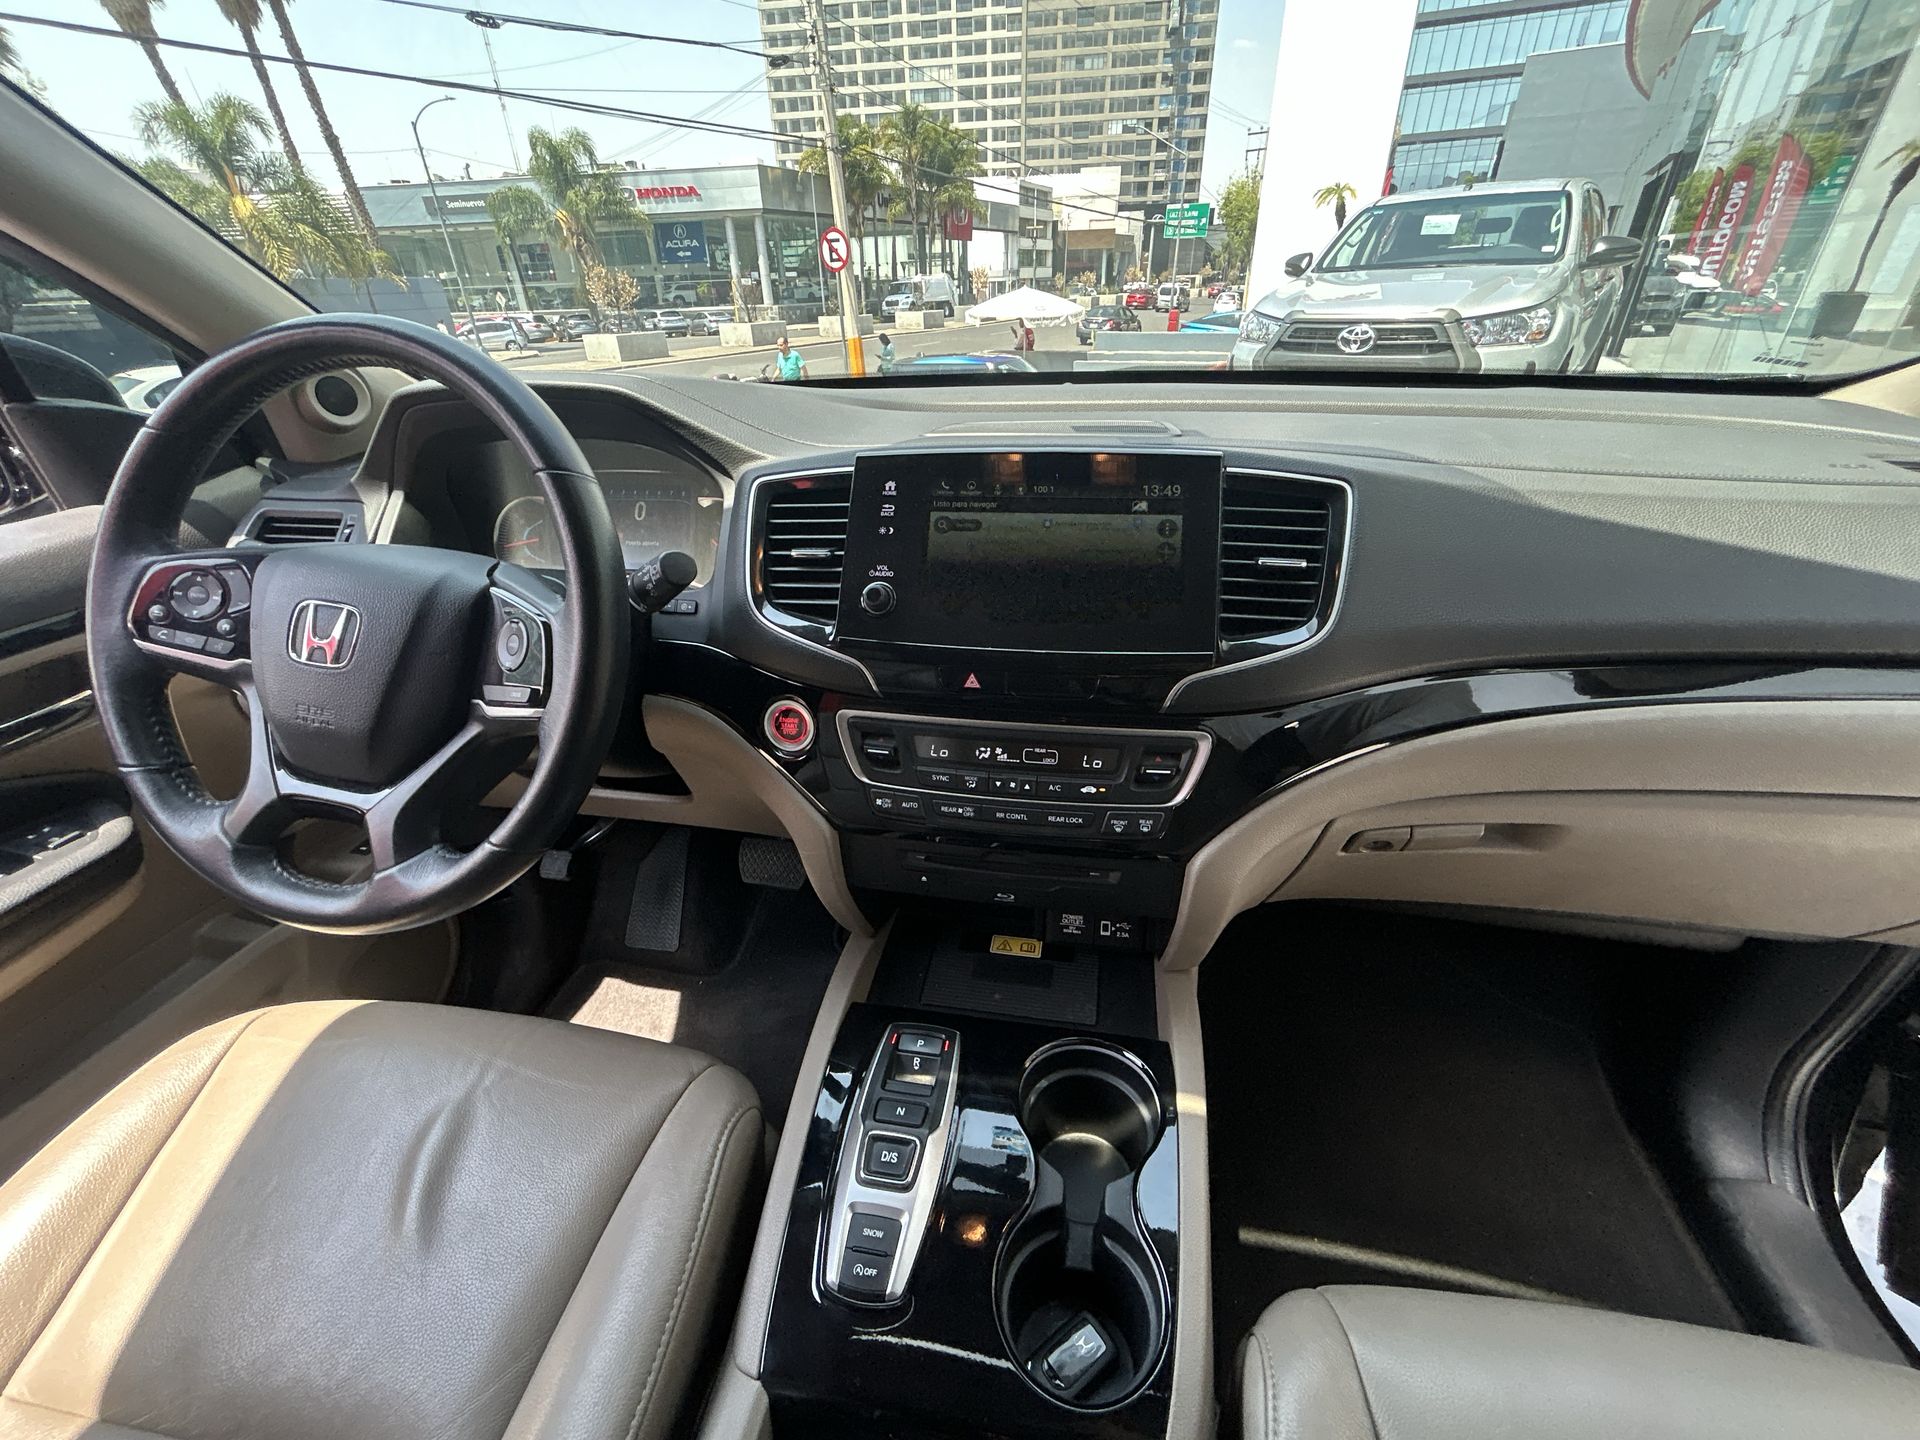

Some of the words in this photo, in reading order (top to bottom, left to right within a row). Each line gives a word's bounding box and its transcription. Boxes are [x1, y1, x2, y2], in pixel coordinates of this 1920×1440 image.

[635, 186, 702, 199] HONDA
[445, 199, 486, 209] Seminuevos
[665, 239, 700, 249] ACURA
[1142, 484, 1182, 497] 13:49
[634, 501, 647, 521] 0
[930, 744, 949, 758] Lo
[1082, 755, 1103, 769] Lo
[931, 774, 950, 782] SYNC
[1048, 784, 1062, 792] A/C
[901, 801, 918, 809] AUTO
[1006, 813, 1028, 821] CONTL
[1048, 815, 1064, 823] REAR
[1066, 816, 1083, 824] LOCK
[916, 1040, 925, 1048] P
[913, 1057, 921, 1066] R
[896, 1106, 906, 1115] N
[881, 1150, 899, 1163] D/S
[862, 1227, 884, 1239] SNOW
[863, 1267, 878, 1277] OFF
